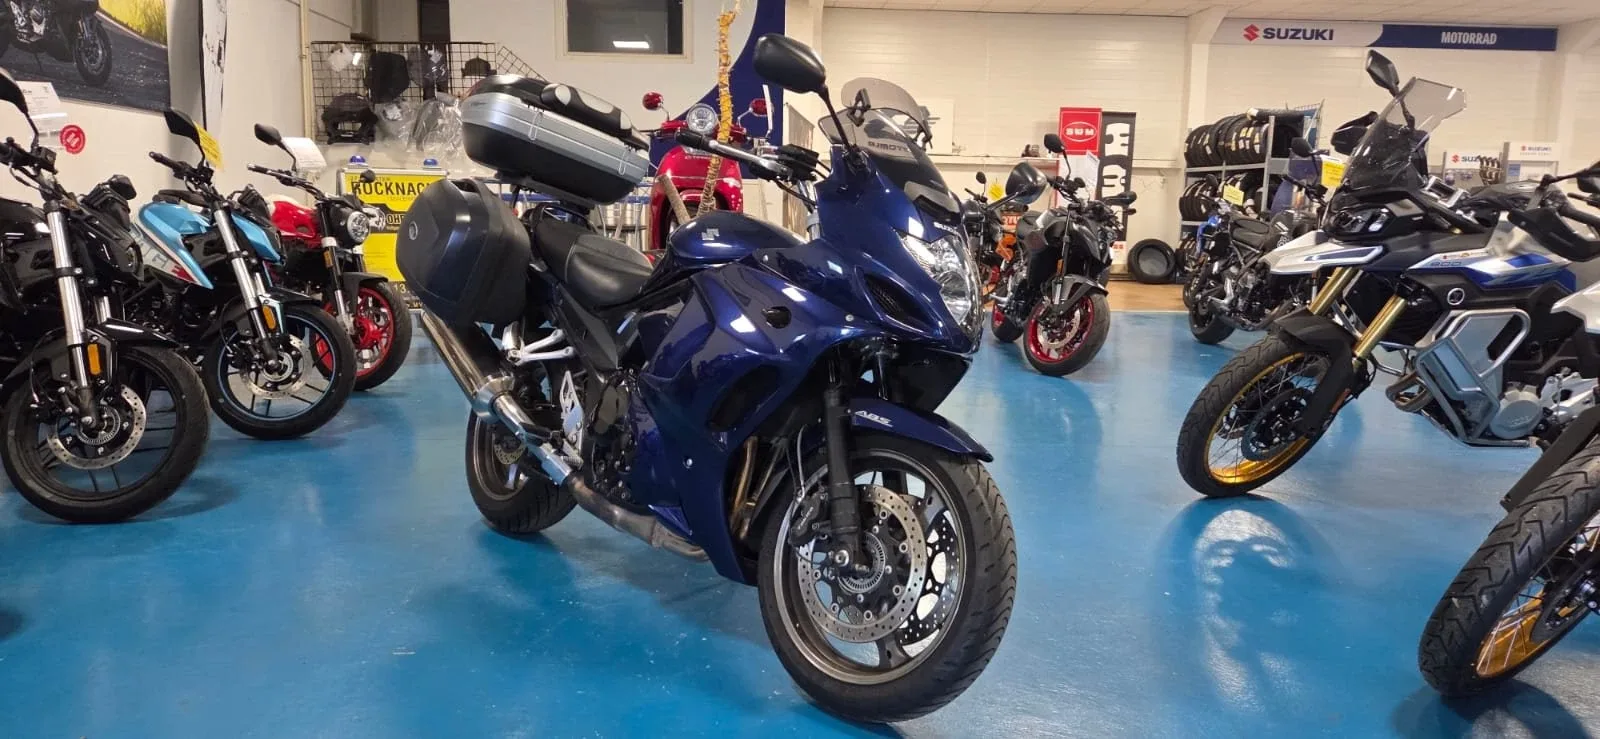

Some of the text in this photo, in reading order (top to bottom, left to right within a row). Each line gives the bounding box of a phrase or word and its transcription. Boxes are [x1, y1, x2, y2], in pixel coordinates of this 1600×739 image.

[1263, 27, 1333, 41] SUZUKI
[1441, 31, 1497, 45] MOTORRAD
[854, 410, 892, 425] ABS
